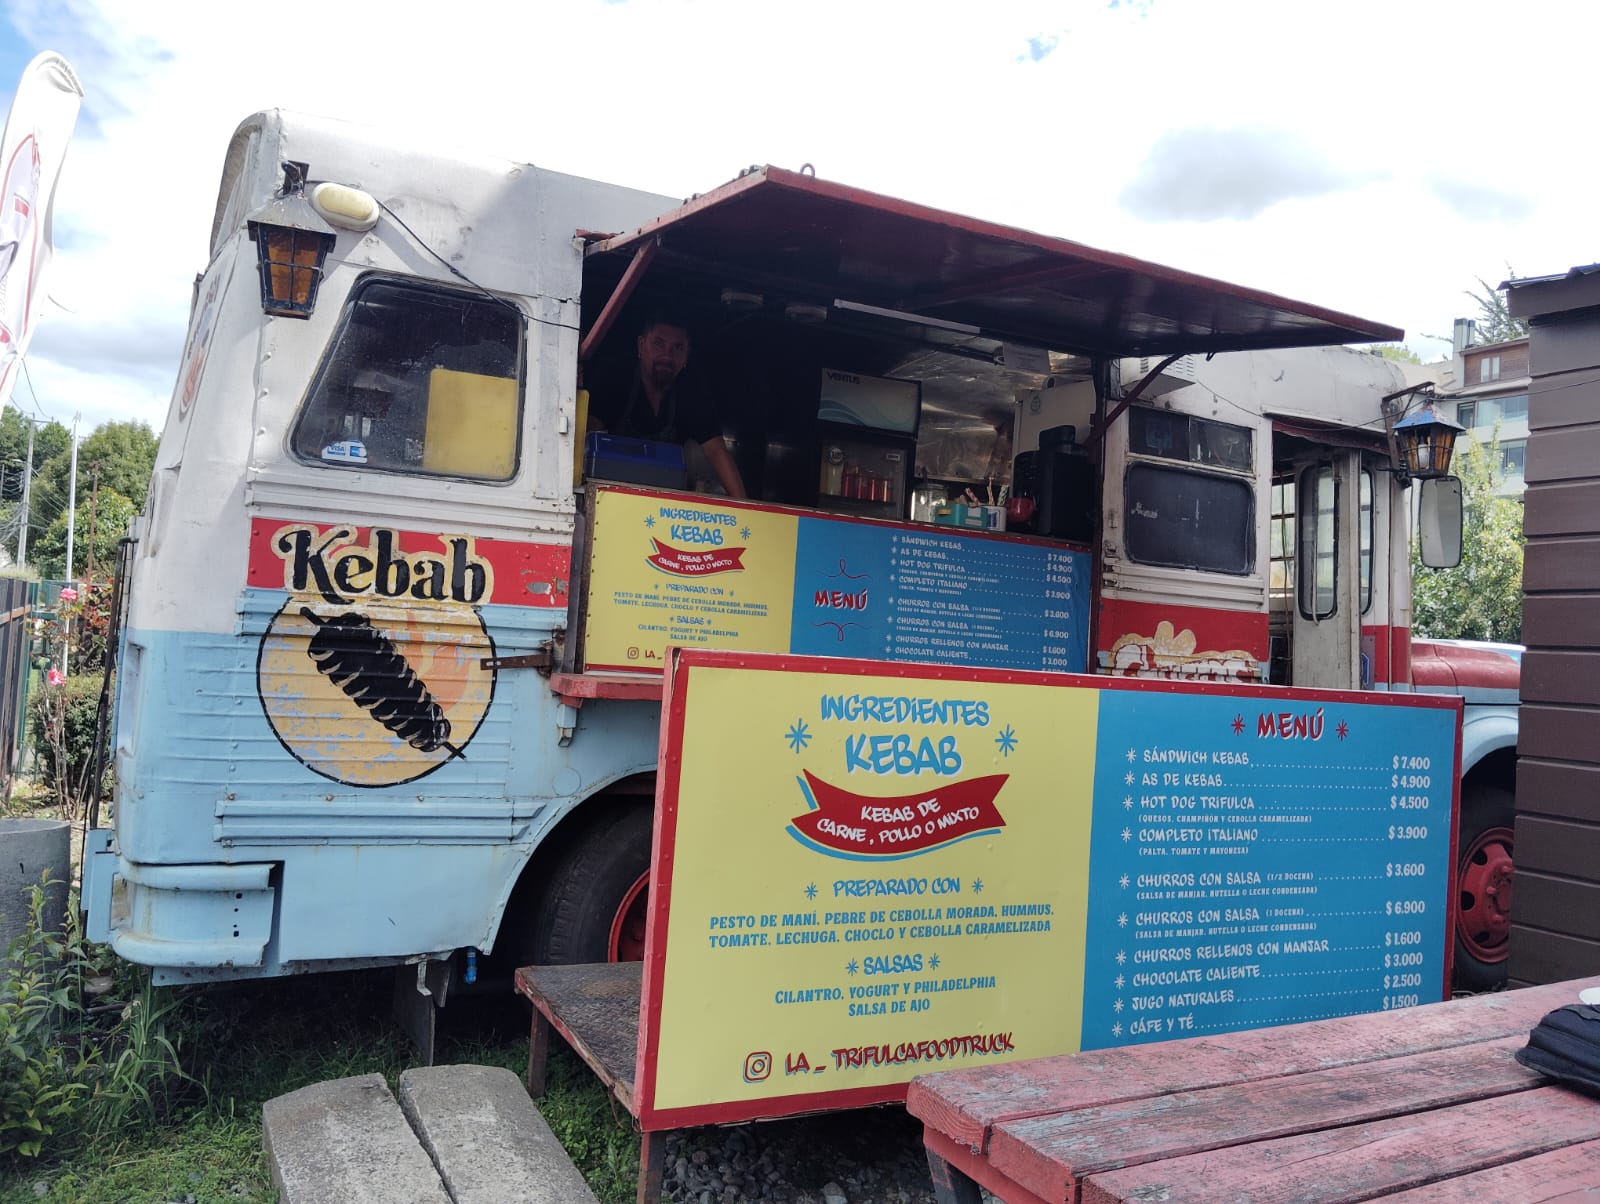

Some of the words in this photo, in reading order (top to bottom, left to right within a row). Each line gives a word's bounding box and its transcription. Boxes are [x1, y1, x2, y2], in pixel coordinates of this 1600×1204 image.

[670, 524, 724, 546] KEBAB
[278, 529, 487, 605] Kebab
[678, 553, 702, 564] KEBAB
[703, 553, 714, 561] DE
[917, 560, 930, 568] DOG
[899, 576, 934, 586] COMPLETO
[666, 584, 708, 595] PREPARADO
[710, 586, 724, 596] CON
[814, 588, 868, 611] MENÚ
[898, 598, 930, 608] CHURROS
[932, 601, 946, 609] CON
[676, 616, 704, 626] SALSAS
[896, 617, 929, 626] CHURROS
[932, 620, 944, 628] CON
[896, 636, 928, 646] CHURROS
[930, 638, 964, 648] RELLENOS
[966, 641, 980, 649] CON
[895, 647, 934, 657] CHOCOLATE
[1257, 707, 1324, 741] MENÚ
[846, 733, 963, 776] KEBAB
[1212, 752, 1249, 765] KEBAB
[1142, 773, 1158, 786] AS
[1163, 773, 1180, 786] DE
[1184, 774, 1223, 787] KEBAB
[861, 805, 914, 823] KEBAB
[917, 798, 941, 817] DE
[1140, 796, 1167, 809] HOT
[1172, 796, 1196, 809] DOG
[879, 824, 922, 843] POLLO
[926, 822, 936, 834] O
[1138, 829, 1203, 842] COMPLETO
[1171, 847, 1200, 856] TOMATE
[1203, 847, 1208, 855] Y
[833, 878, 927, 897] PREPARADO
[932, 878, 960, 894] CON
[1137, 874, 1194, 888] CHURROS
[1200, 873, 1222, 886] CON
[1226, 872, 1262, 885] SALSA
[1210, 890, 1240, 898] NUTELLA
[1250, 888, 1270, 896] LECHE
[710, 916, 756, 930] PESTO
[760, 915, 778, 928] DE
[824, 912, 866, 925] PEBRE
[870, 911, 886, 923] DE
[890, 908, 942, 922] CEBOLLA
[1136, 912, 1193, 926] CHURROS
[1198, 910, 1220, 924] CON
[1224, 908, 1260, 922] SALSA
[844, 928, 894, 942] CHOCLO
[898, 927, 906, 938] Y
[910, 924, 962, 938] CEBOLLA
[966, 920, 1051, 935] CARAMELIZADA
[1164, 930, 1174, 938] DE
[1208, 927, 1238, 935] NUTELLA
[1134, 948, 1192, 964] CHURROS
[1196, 944, 1252, 959] RELLENOS
[1257, 942, 1279, 956] CON
[1284, 940, 1329, 954] MANJAR
[863, 953, 924, 976] SALSAS
[1133, 969, 1202, 987] CHOCOLATE
[850, 984, 899, 999] YOGURT
[903, 982, 911, 994] Y
[914, 976, 996, 994] PHILADELPHIA
[848, 1003, 886, 1016] SALSA
[890, 1000, 906, 1013] DE
[910, 999, 930, 1012] AJO
[1132, 995, 1164, 1010] JUGO
[1168, 990, 1234, 1008] NATURALES
[1130, 1016, 1162, 1035] CÁFE
[1167, 1018, 1174, 1031] Y
[1178, 1013, 1194, 1030] TÉ
